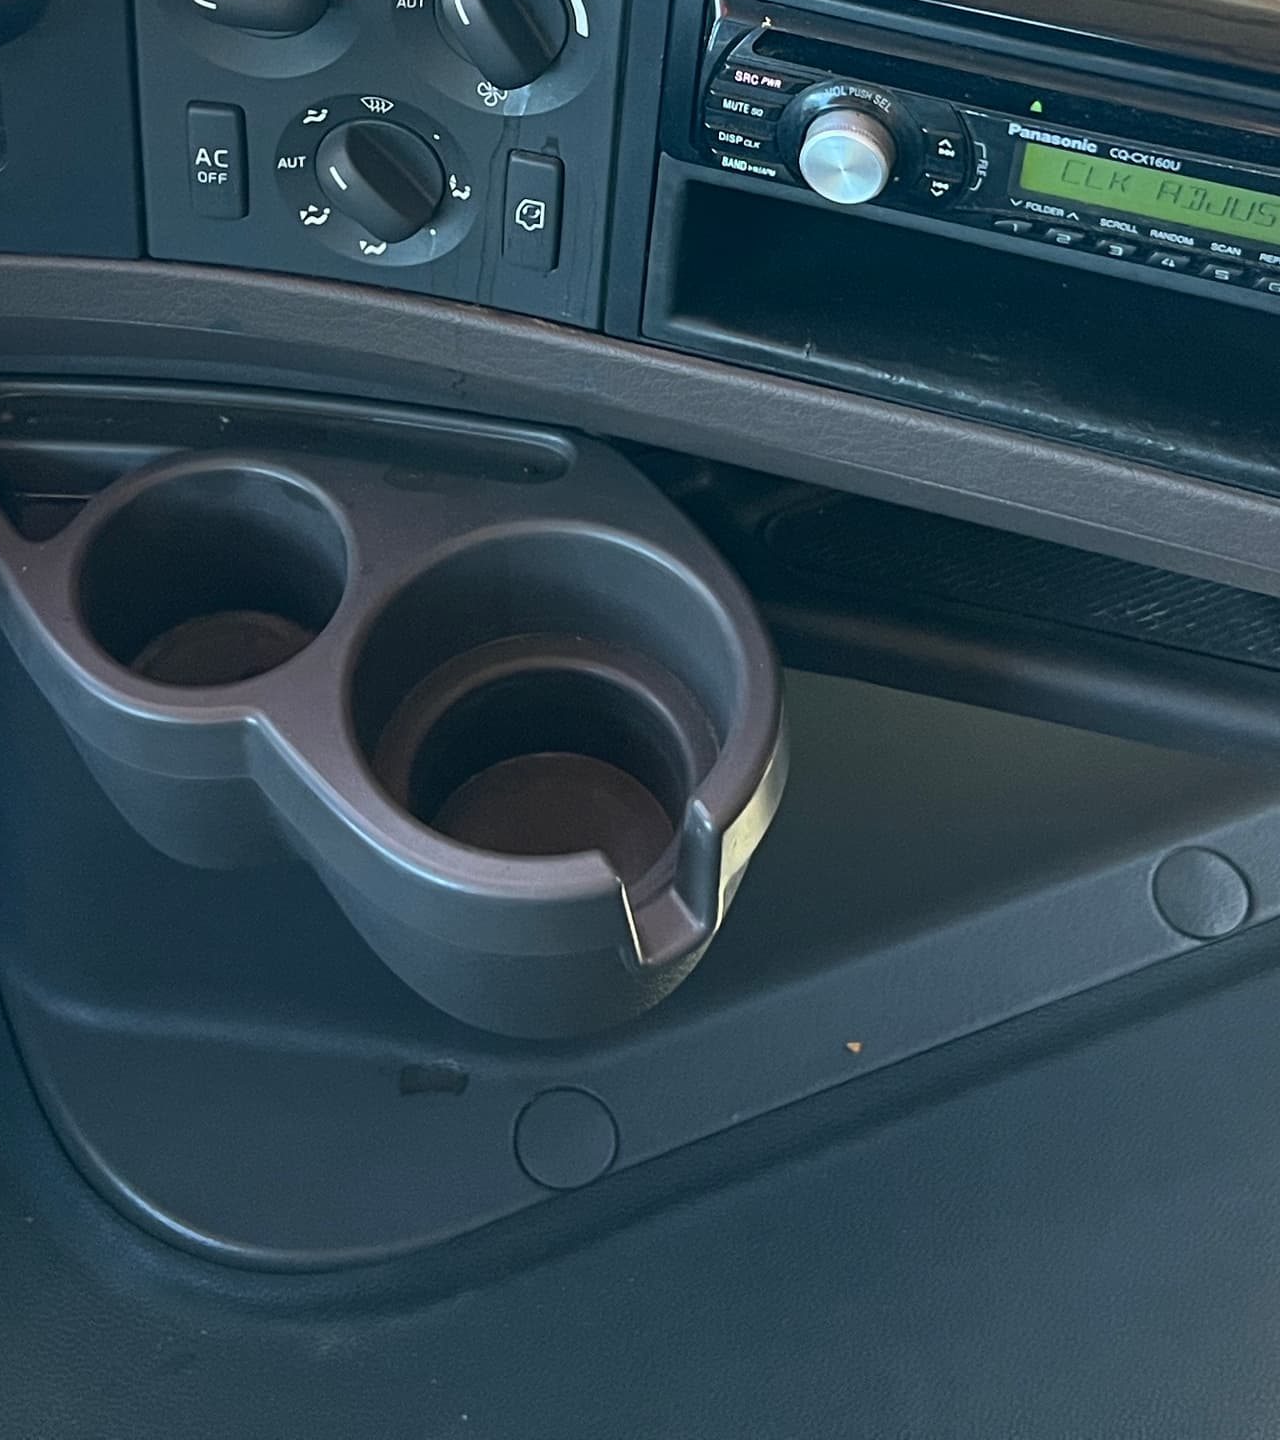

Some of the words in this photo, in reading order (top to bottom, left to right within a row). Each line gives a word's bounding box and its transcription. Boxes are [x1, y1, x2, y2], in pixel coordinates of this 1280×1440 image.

[734, 70, 759, 86] SRC
[760, 76, 782, 89] PWR
[722, 98, 750, 114] MUTE
[824, 85, 847, 97] VOL
[848, 86, 873, 101] PUSH
[872, 94, 892, 113] SEL
[718, 131, 743, 145] DISP
[743, 139, 761, 149] CLK
[1007, 122, 1099, 154] Panasonic
[195, 147, 229, 168] AC
[277, 155, 307, 169] AUT
[721, 156, 748, 171] BAND
[1109, 147, 1182, 172] CQ-CX160U
[197, 170, 228, 185] OFF
[1060, 159, 1132, 193] CLK
[1024, 201, 1065, 217] FOLDER
[1099, 217, 1139, 234] SCROLL
[1055, 233, 1071, 245] 2
[1149, 229, 1195, 246] RANDOM
[1108, 245, 1124, 256] 3
[1209, 242, 1243, 256] SCAN
[1160, 257, 1176, 268] 4
[1214, 269, 1230, 281] 5
